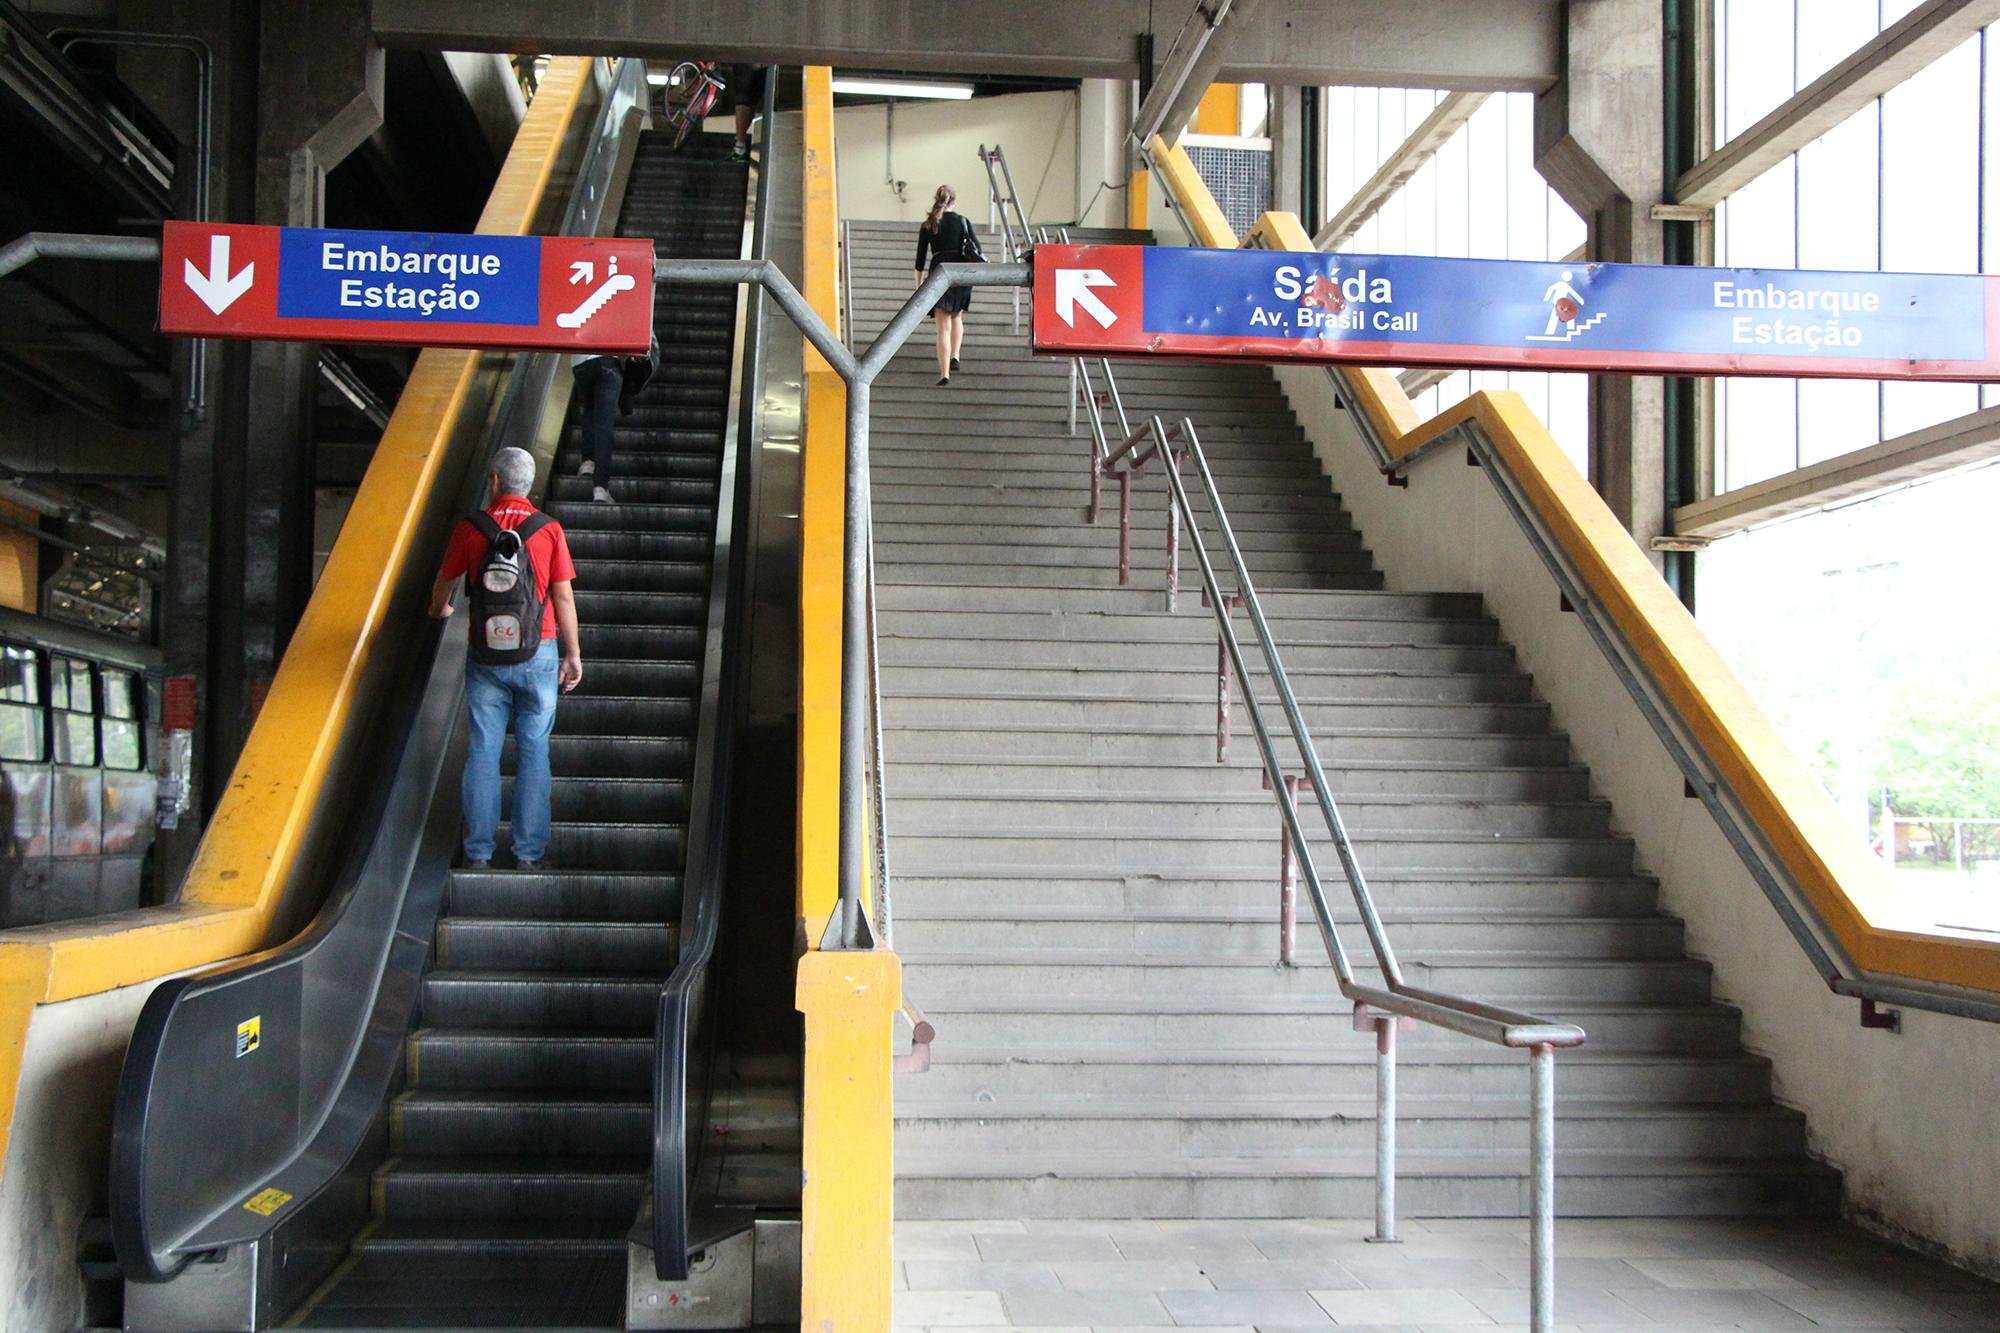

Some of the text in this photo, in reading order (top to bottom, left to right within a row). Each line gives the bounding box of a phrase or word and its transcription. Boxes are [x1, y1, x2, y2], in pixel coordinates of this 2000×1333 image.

[322, 242, 501, 281] Embarque
[340, 279, 480, 316] Estação
[1713, 281, 1881, 317] Embarque
[1249, 306, 1418, 332] Av. Brasil Call
[1732, 316, 1862, 352] Estação
